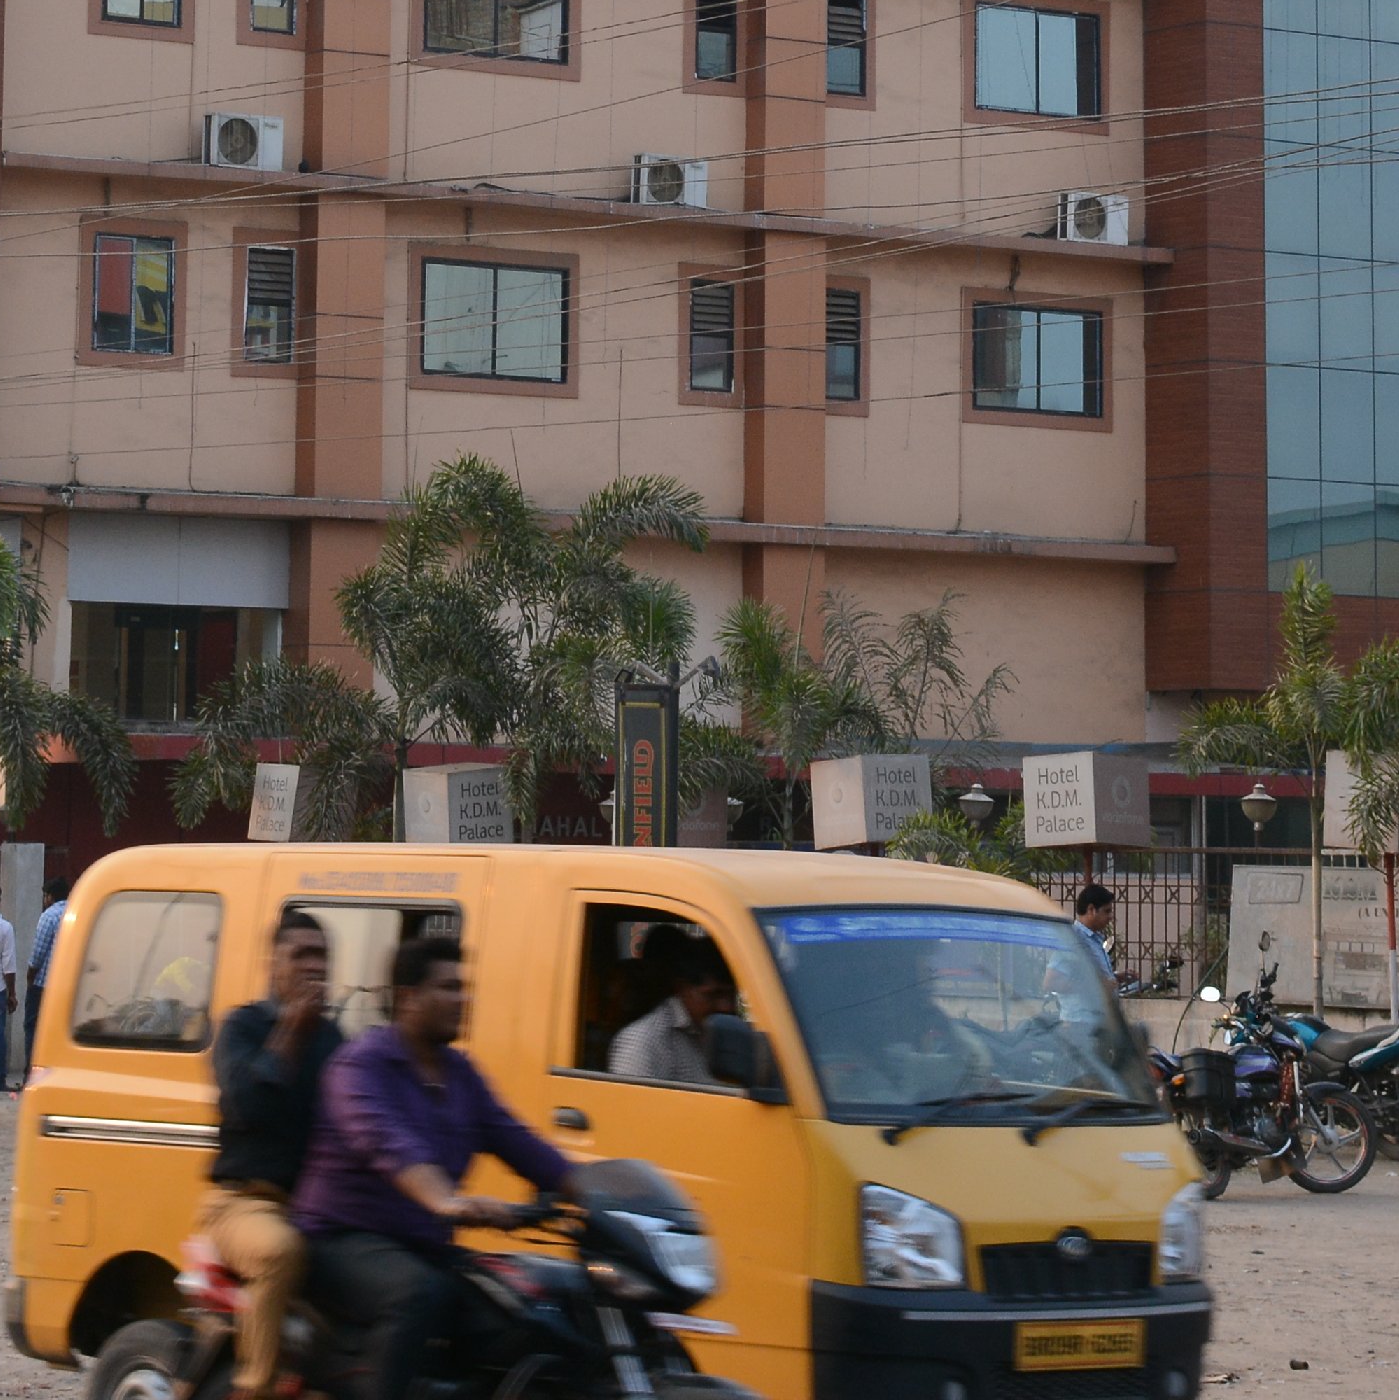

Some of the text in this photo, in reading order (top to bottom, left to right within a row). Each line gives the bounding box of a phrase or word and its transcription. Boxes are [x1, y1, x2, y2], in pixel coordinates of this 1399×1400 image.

[262, 774, 289, 792] Hotel
[875, 766, 918, 784] Hotel
[1037, 765, 1080, 786] Hotel
[460, 781, 500, 799] Hotel
[632, 738, 656, 847] NFIELD
[875, 790, 921, 808] K.D.M.
[1036, 789, 1082, 810] K.D.M.
[459, 800, 503, 820] K.D.M.
[255, 813, 286, 833] Palace
[875, 812, 906, 831] Pala
[1035, 815, 1086, 835] Palace
[458, 822, 505, 841] Palace
